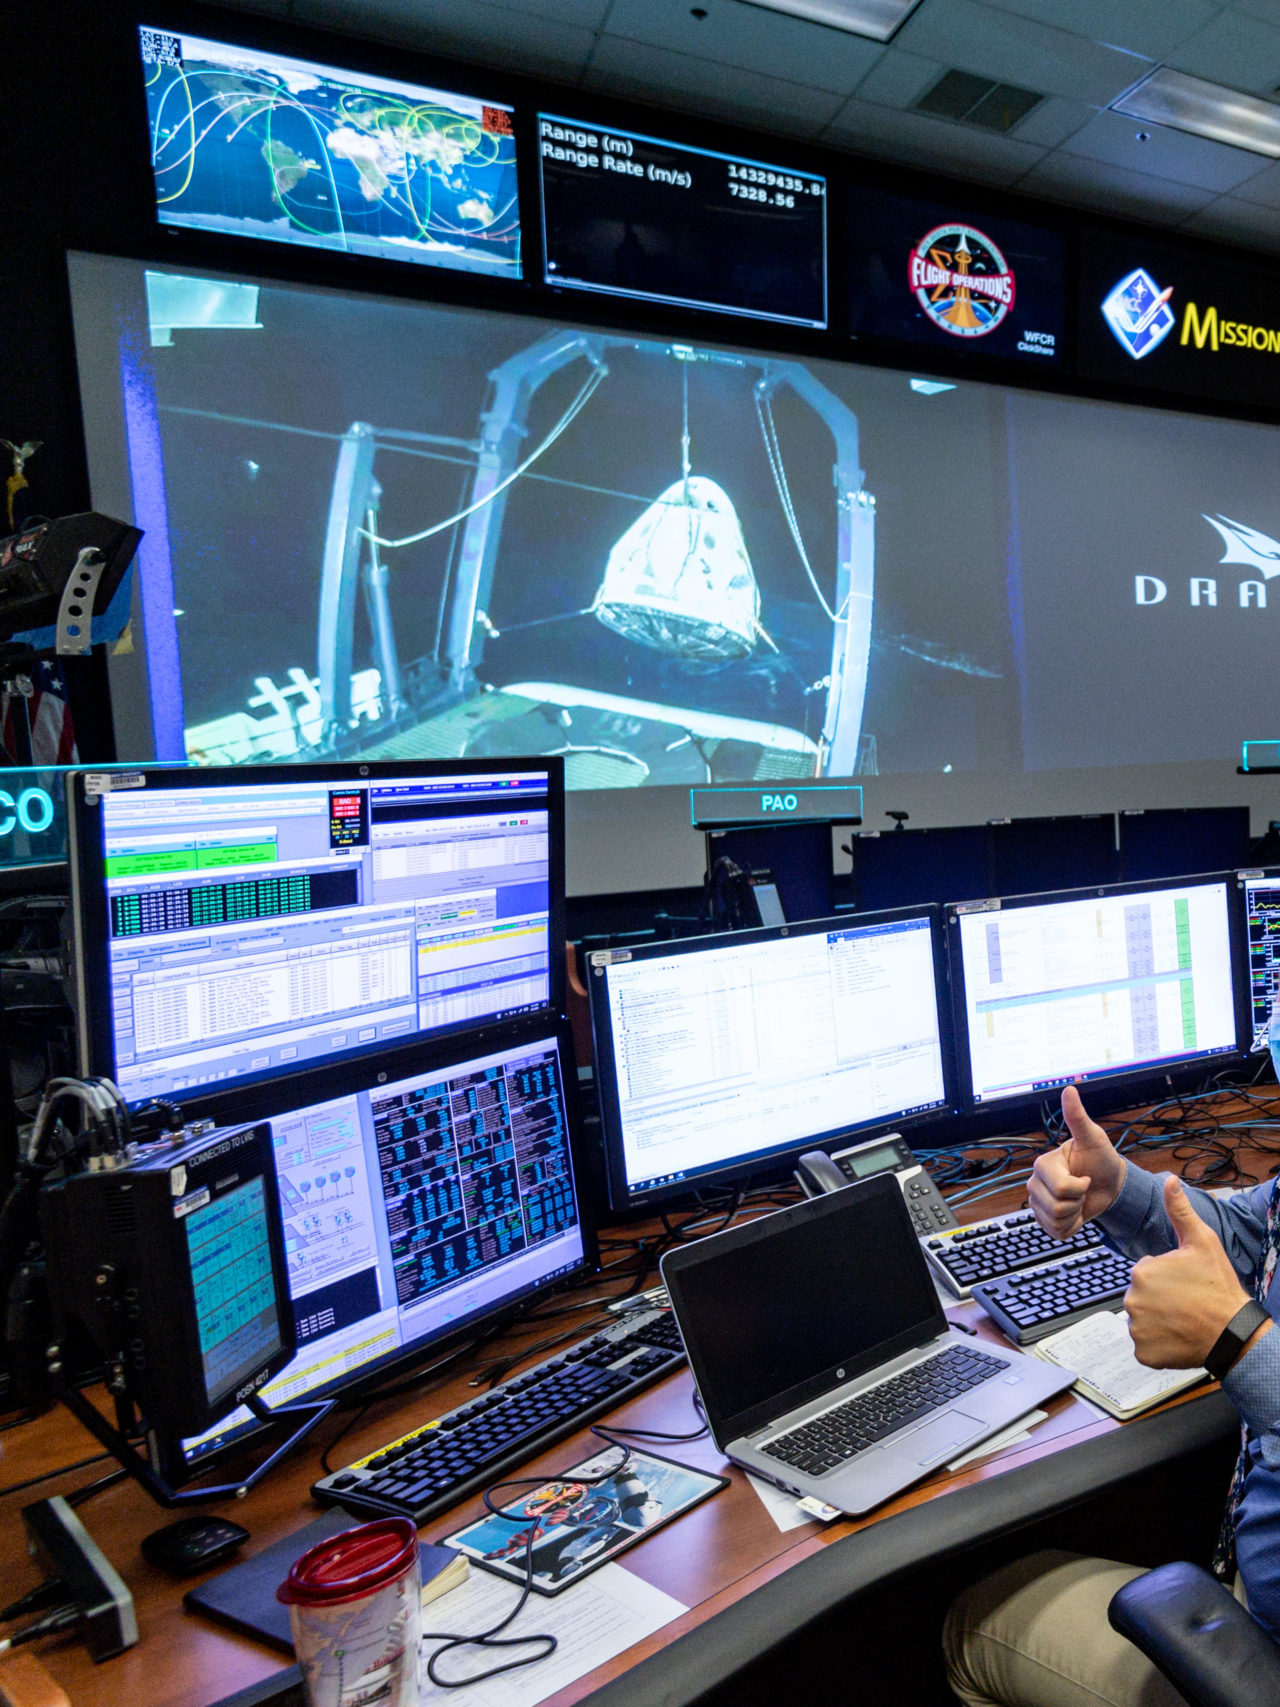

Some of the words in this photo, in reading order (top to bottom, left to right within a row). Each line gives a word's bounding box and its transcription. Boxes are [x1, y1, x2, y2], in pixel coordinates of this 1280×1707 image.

[541, 122, 598, 148] Range
[602, 134, 634, 157] (m)
[541, 141, 599, 168] Range
[603, 155, 644, 177] Rate
[648, 164, 691, 188] (m/s)
[728, 182, 795, 208] 7328.56
[912, 257, 951, 287] FLIGHT
[952, 273, 1012, 304] OPERATIONS
[1024, 330, 1055, 346] WFCR
[761, 794, 798, 812] PAO
